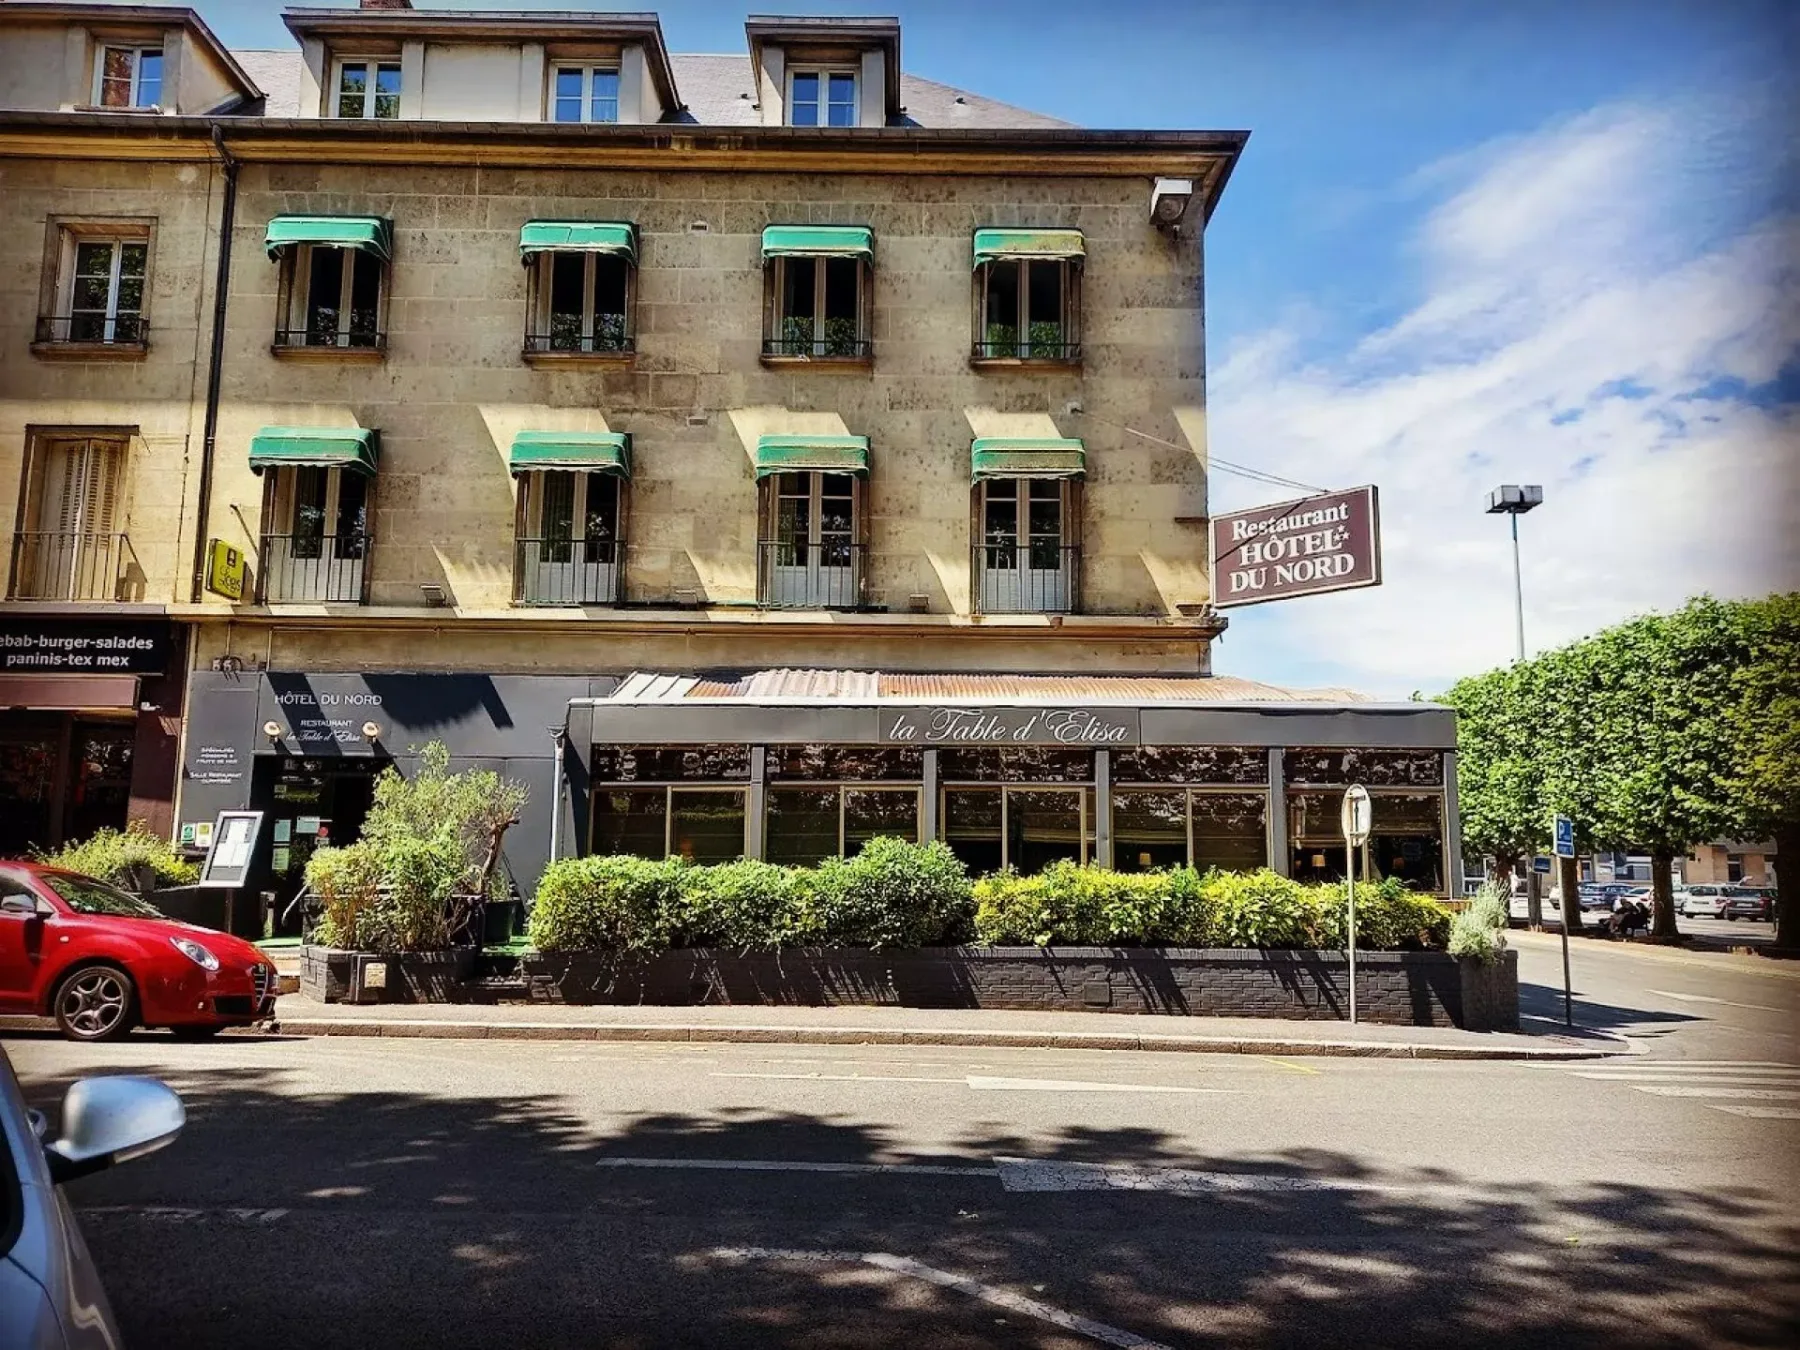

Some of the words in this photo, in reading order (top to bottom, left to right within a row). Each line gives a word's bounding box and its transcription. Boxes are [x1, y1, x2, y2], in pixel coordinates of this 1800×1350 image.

[1231, 502, 1349, 541] Restaurant
[1239, 529, 1342, 567] HÔTEL
[1229, 567, 1268, 593] DU
[1273, 553, 1355, 587] NORD
[6, 652, 93, 667] paninis-tex
[96, 655, 130, 666] mex
[274, 690, 316, 705] HÔTEL
[320, 693, 340, 705] DU
[344, 693, 383, 706] NORD
[300, 719, 354, 728] RESTAURANT
[889, 715, 918, 741] la
[925, 707, 1006, 741] Table
